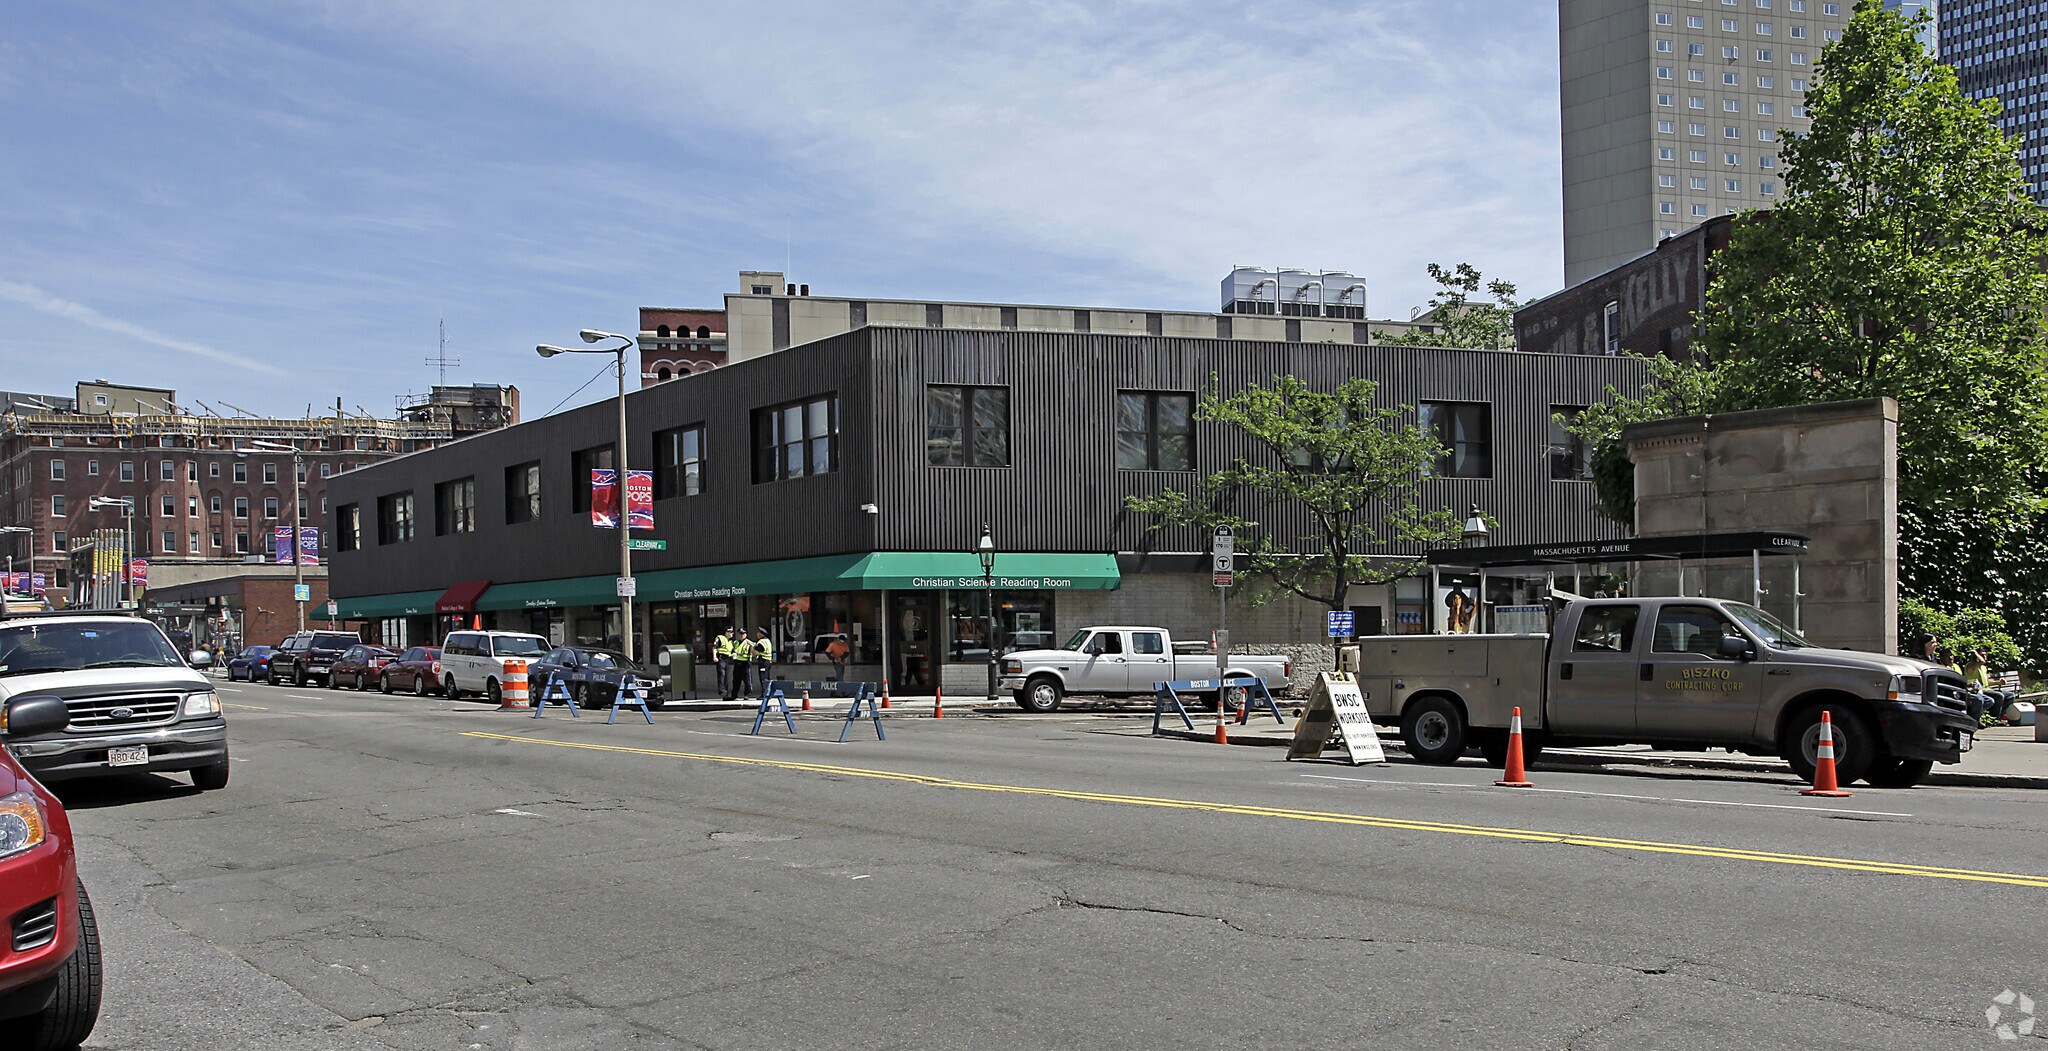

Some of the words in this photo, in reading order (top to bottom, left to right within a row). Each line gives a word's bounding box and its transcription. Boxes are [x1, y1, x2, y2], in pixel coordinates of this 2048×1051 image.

[1620, 251, 1691, 344] KELLY
[635, 540, 659, 549] CLEARWAY
[1533, 547, 1596, 557] MASSACHUSETTS
[1600, 544, 1630, 553] AVENUE
[912, 577, 955, 587] Christian
[958, 577, 996, 587] Science
[1000, 577, 1039, 588] Reading
[1043, 577, 1071, 587] Room
[674, 590, 693, 599] Christian
[694, 588, 711, 598] Science
[712, 587, 731, 597] Reading
[731, 586, 746, 595] Room
[592, 673, 607, 681] POLICE
[1682, 667, 1730, 680] BISZKO
[794, 681, 812, 690] BOSTON
[820, 681, 838, 691] POLICE
[1190, 680, 1210, 689] BOSTON
[1218, 678, 1236, 687] LICE
[1665, 681, 1717, 690] CONTRACTING
[1722, 682, 1743, 691] CORP
[1334, 693, 1360, 707] BWSC
[1338, 712, 1371, 724] WORKSITE
